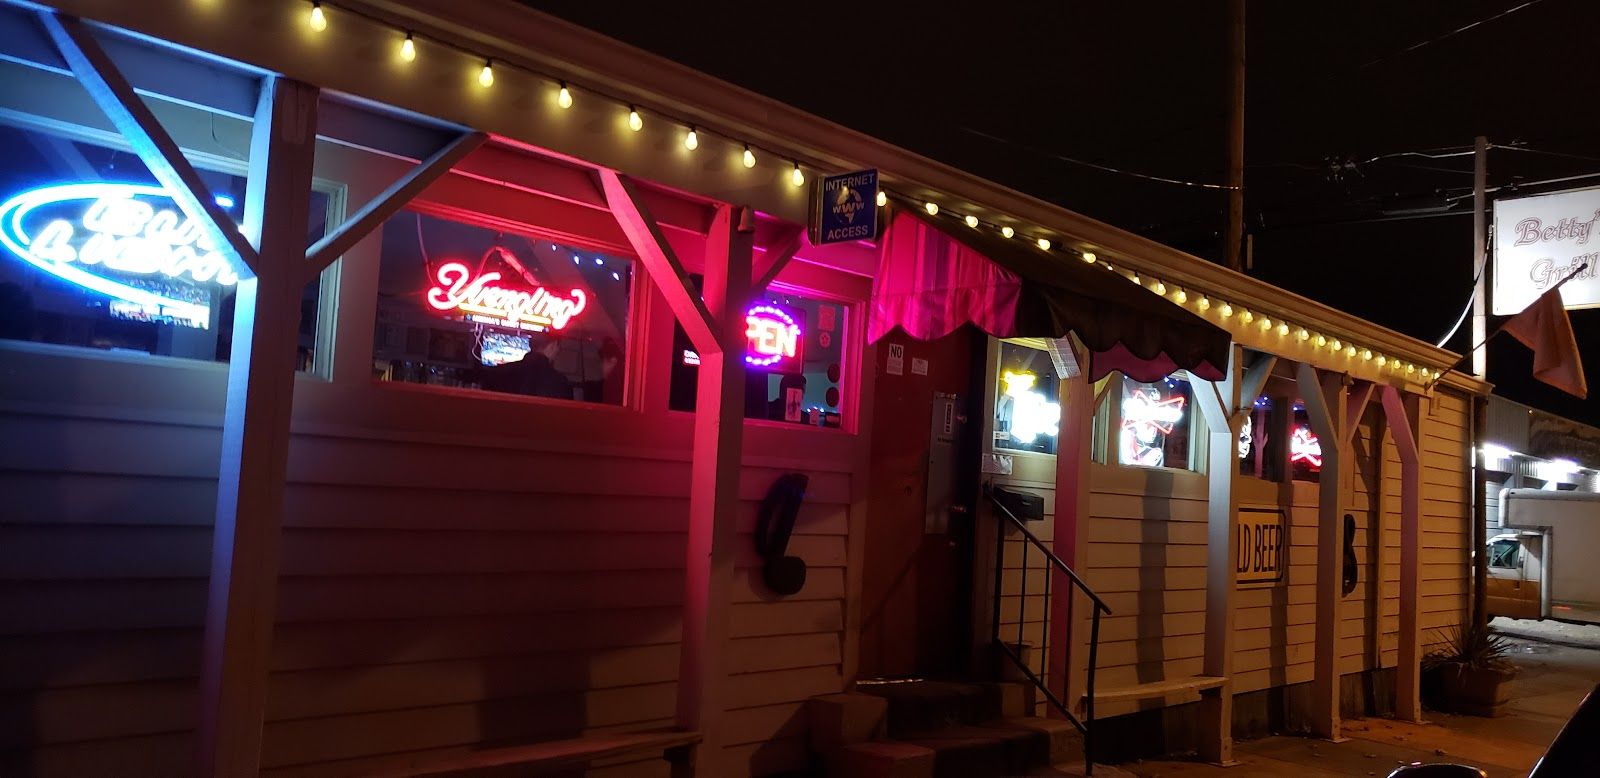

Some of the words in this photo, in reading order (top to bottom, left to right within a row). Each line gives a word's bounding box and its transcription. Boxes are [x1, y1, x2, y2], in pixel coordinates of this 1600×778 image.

[825, 173, 875, 191] INTERNET
[827, 225, 869, 241] ACCESS
[1515, 208, 1600, 246] Betty'
[427, 262, 587, 329] Yuengling
[745, 315, 799, 358] PEN
[890, 345, 903, 359] NO
[1236, 523, 1251, 573] LD
[1253, 523, 1283, 573] BEER
